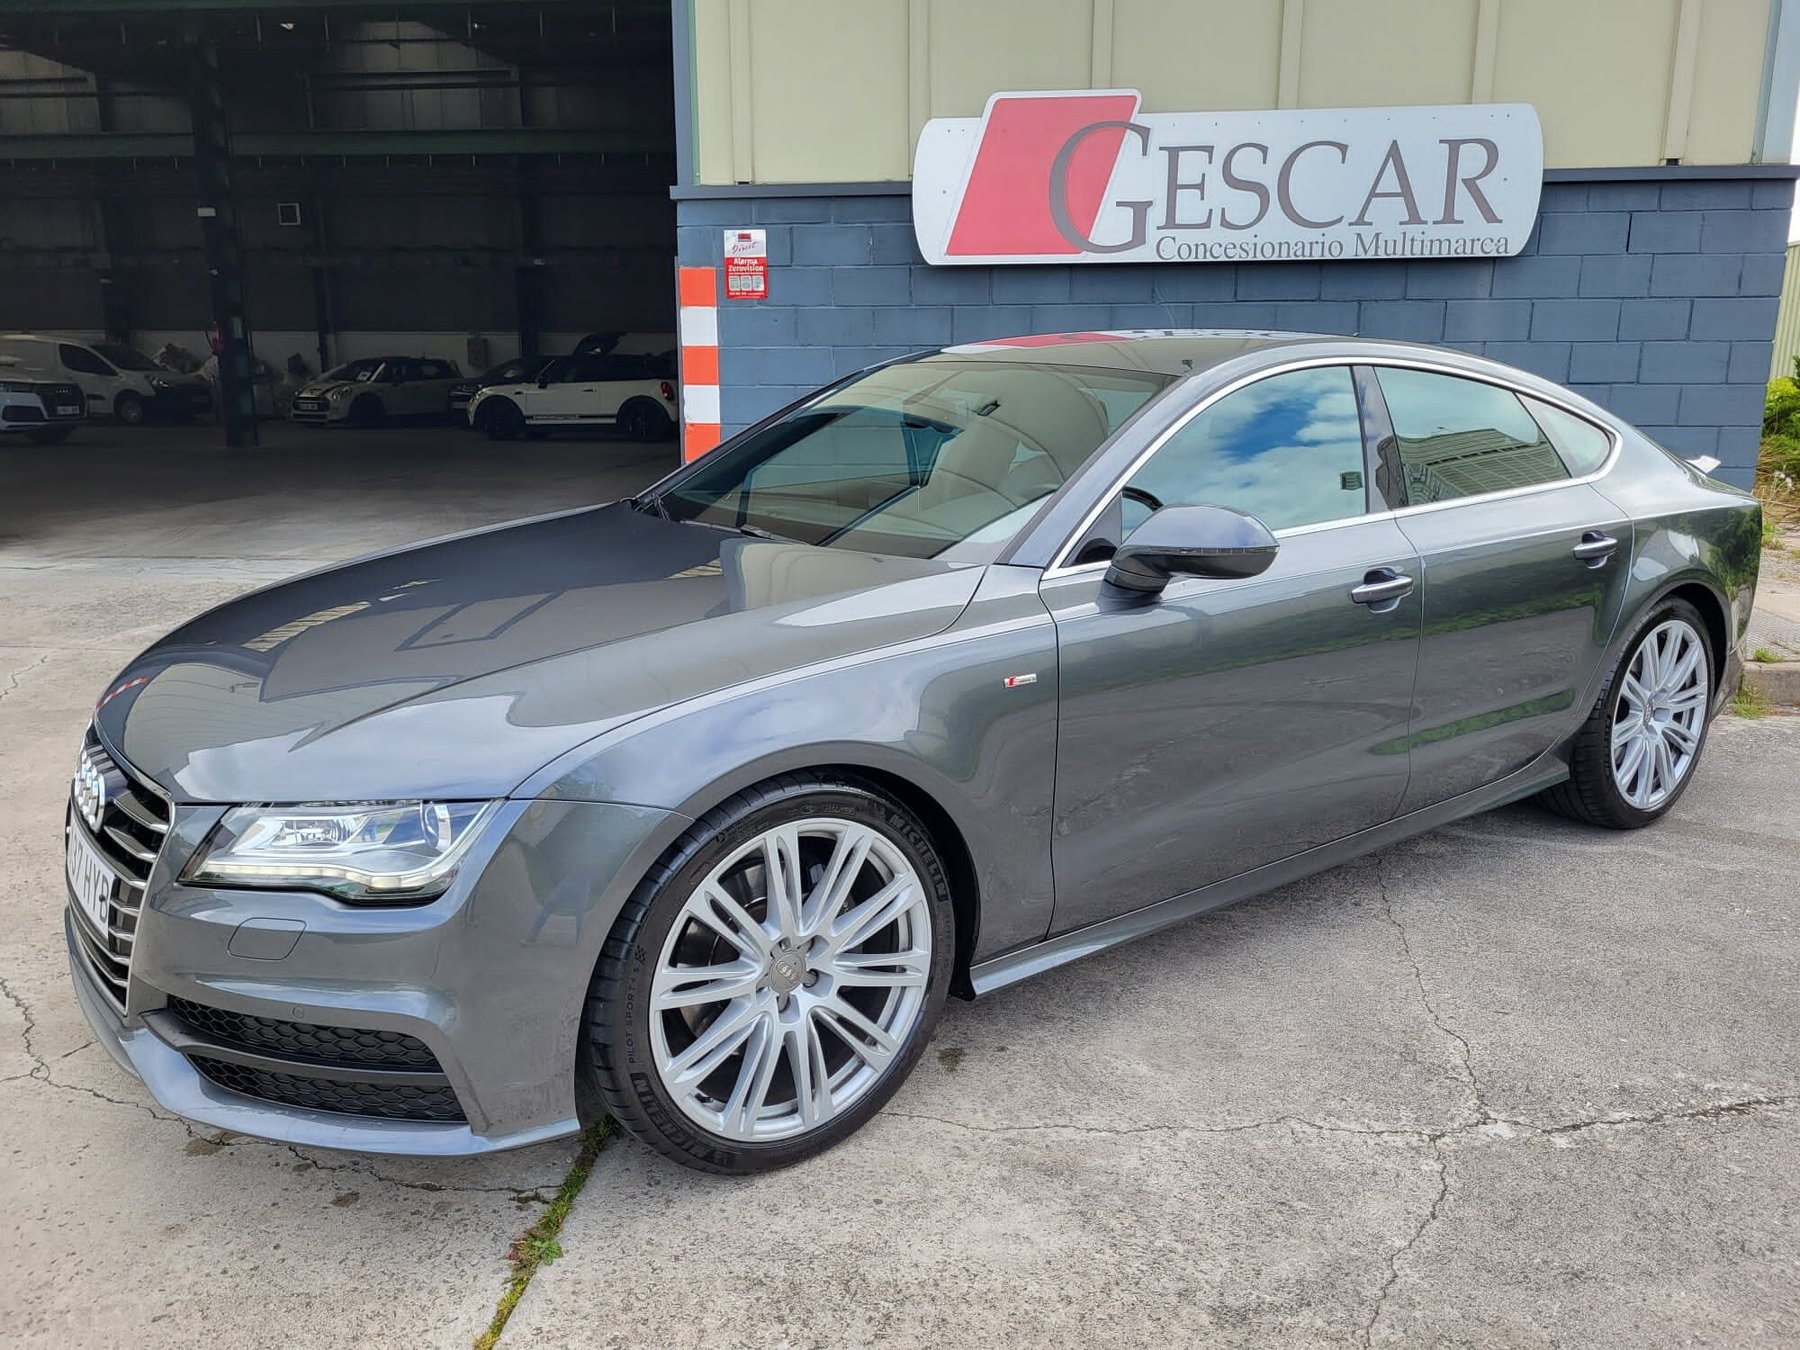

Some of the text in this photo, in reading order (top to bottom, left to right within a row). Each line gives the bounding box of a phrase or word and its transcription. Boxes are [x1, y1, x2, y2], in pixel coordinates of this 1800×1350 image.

[1048, 120, 1503, 254] GESCAR
[1156, 231, 1510, 261] Concesionario Multimarca
[625, 1032, 637, 1064] PILOT
